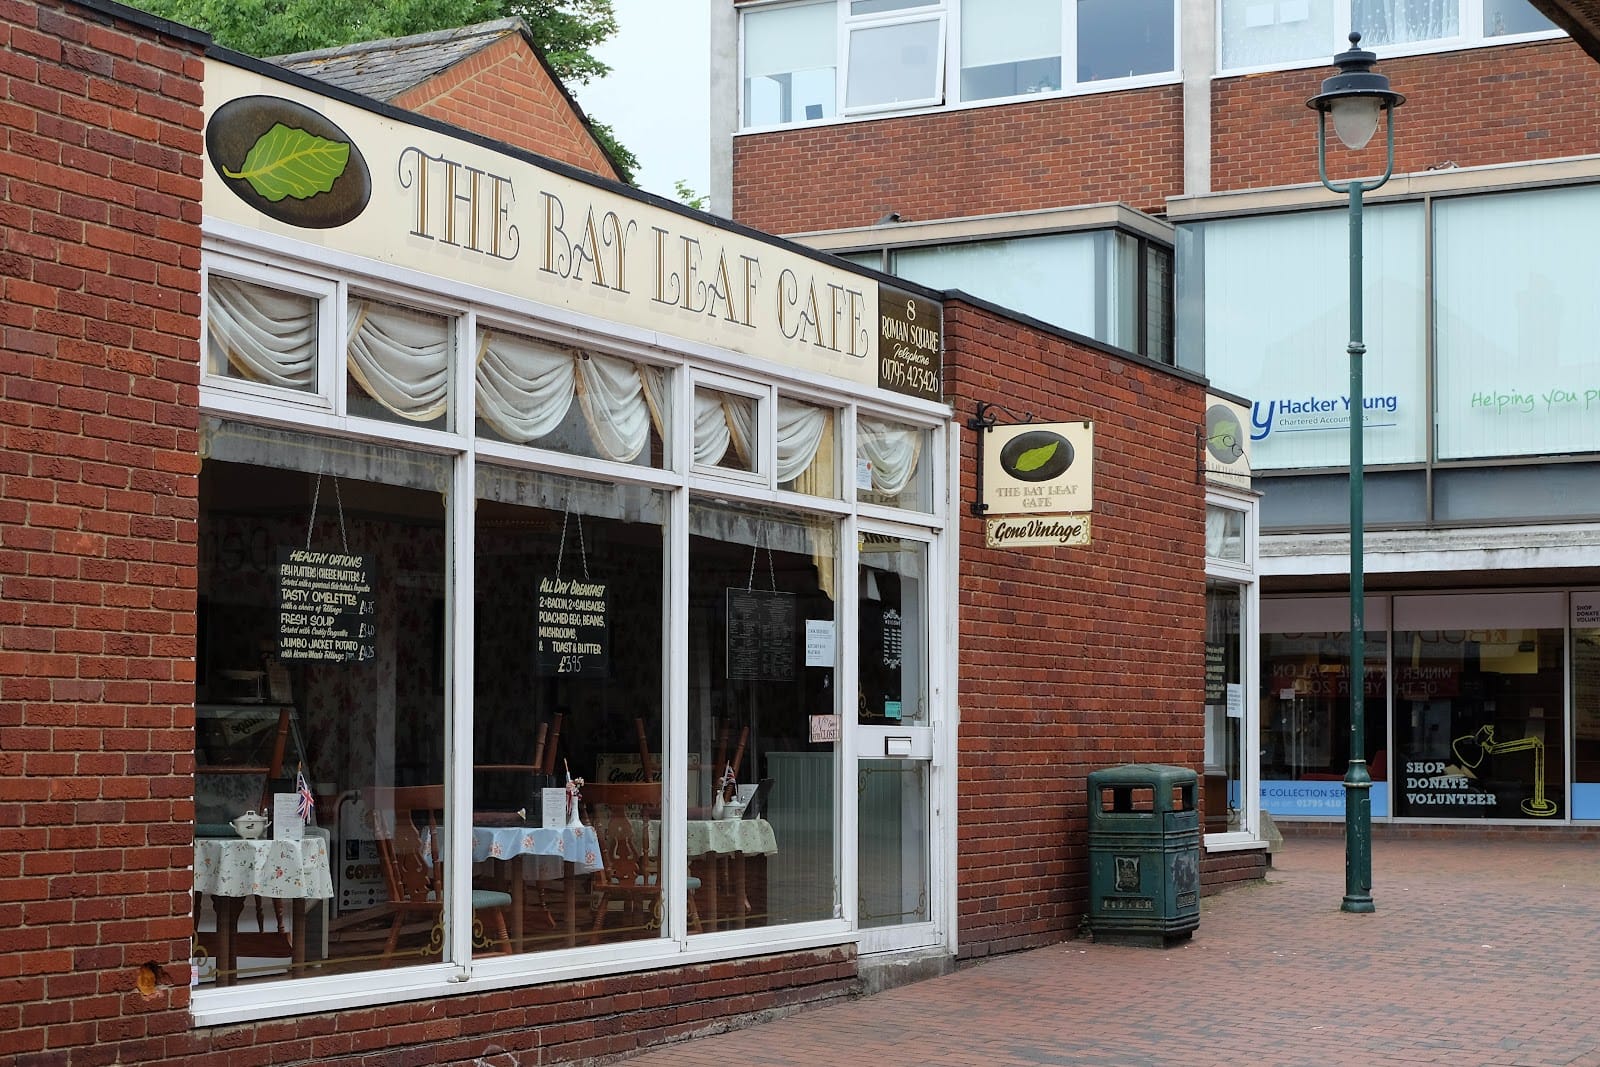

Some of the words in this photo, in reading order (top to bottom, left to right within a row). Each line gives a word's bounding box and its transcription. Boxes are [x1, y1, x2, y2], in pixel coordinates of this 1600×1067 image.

[398, 146, 521, 262] THE
[539, 189, 638, 295] BAY
[650, 226, 761, 329] LEAF
[775, 268, 870, 360] CAFE
[906, 300, 916, 321] 8
[882, 315, 909, 343] ROMAN
[910, 325, 939, 354] SQUARE
[893, 343, 930, 366] Telephone
[882, 358, 905, 388] 01795
[907, 364, 939, 393] 423426
[1279, 397, 1338, 415] Hacker
[1340, 396, 1397, 414] Yung
[1471, 388, 1535, 416] Helping
[1279, 417, 1319, 426] Chartered
[996, 487, 1020, 497] THE
[1048, 484, 1079, 496] LEAF
[1022, 497, 1052, 509] CAFE
[290, 550, 329, 565] HEALTHY
[329, 554, 363, 568] OPTIONS
[280, 564, 293, 576] FISH
[293, 565, 317, 579] PLATTERS
[318, 567, 336, 580] CHEESE
[336, 569, 361, 582] PLATTERS
[281, 588, 310, 602] TASTY
[312, 591, 358, 606] OMELETTES
[281, 612, 308, 625] FRESH
[310, 614, 335, 627] SOUP
[539, 611, 569, 624] POACHED
[280, 637, 308, 649] JUMBO
[308, 639, 334, 650] JACKET
[335, 640, 358, 651] POTATO
[552, 641, 572, 653] TOAST
[577, 643, 602, 655] BUTTER
[1406, 762, 1445, 774] SHOP
[1406, 778, 1469, 789] DONATE
[1269, 788, 1327, 798] COLLECTION
[1329, 789, 1346, 798] SER
[1406, 794, 1497, 805] VOLUNTEER
[1103, 899, 1152, 909] LITTER
